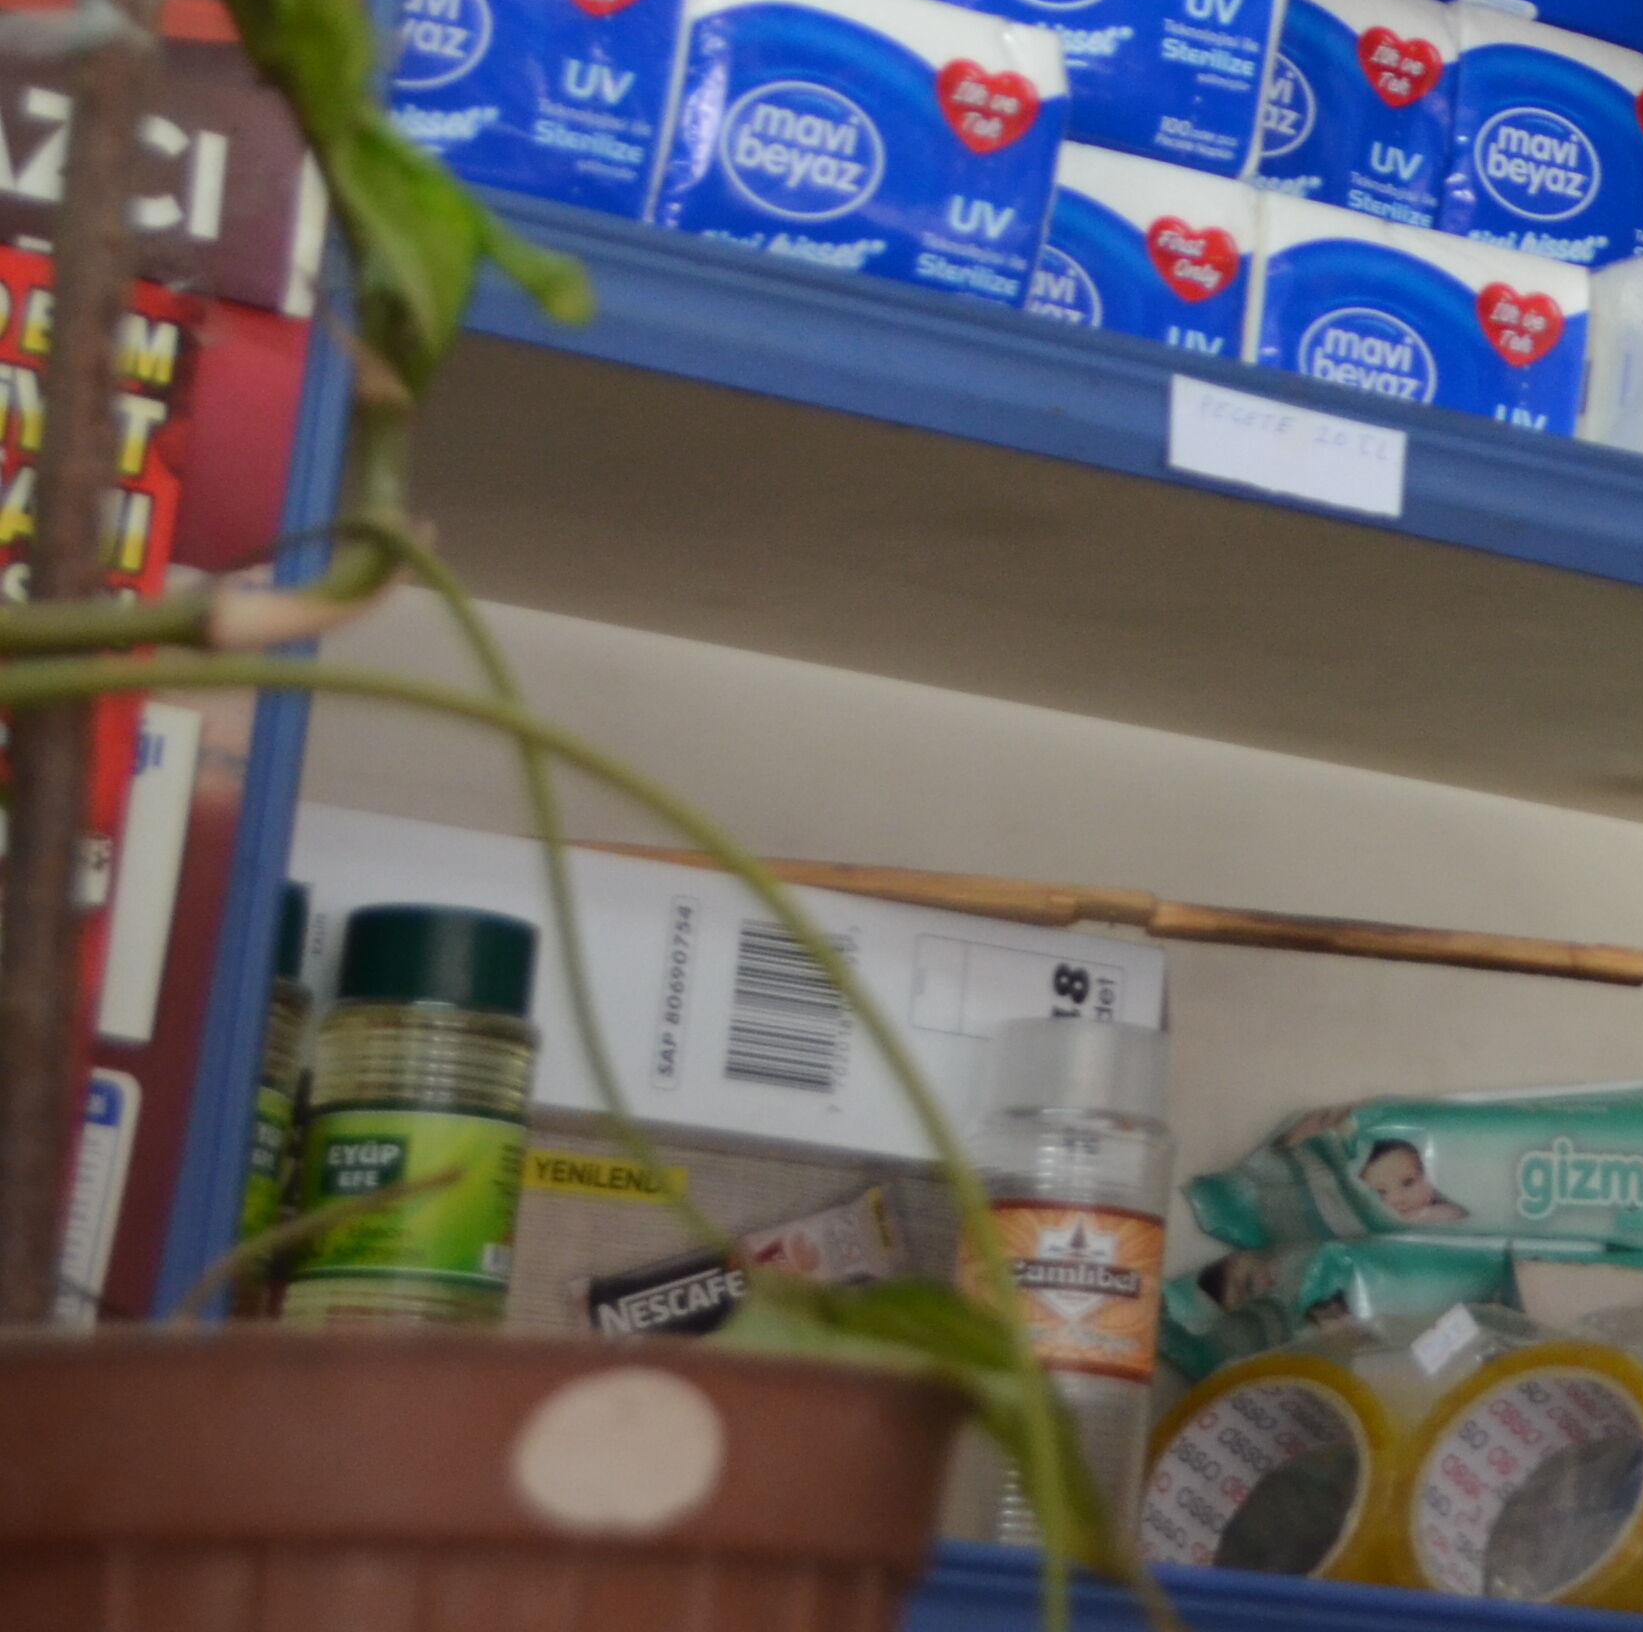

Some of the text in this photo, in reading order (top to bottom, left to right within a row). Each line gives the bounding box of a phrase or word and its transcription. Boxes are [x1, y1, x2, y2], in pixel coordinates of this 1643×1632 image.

[563, 58, 638, 105] UV
[752, 99, 860, 156] mavi
[1498, 123, 1581, 169] mavi
[733, 122, 864, 195] beyaz
[1370, 141, 1424, 181] UV
[1486, 144, 1591, 200] beyaz
[947, 193, 1017, 241] UV
